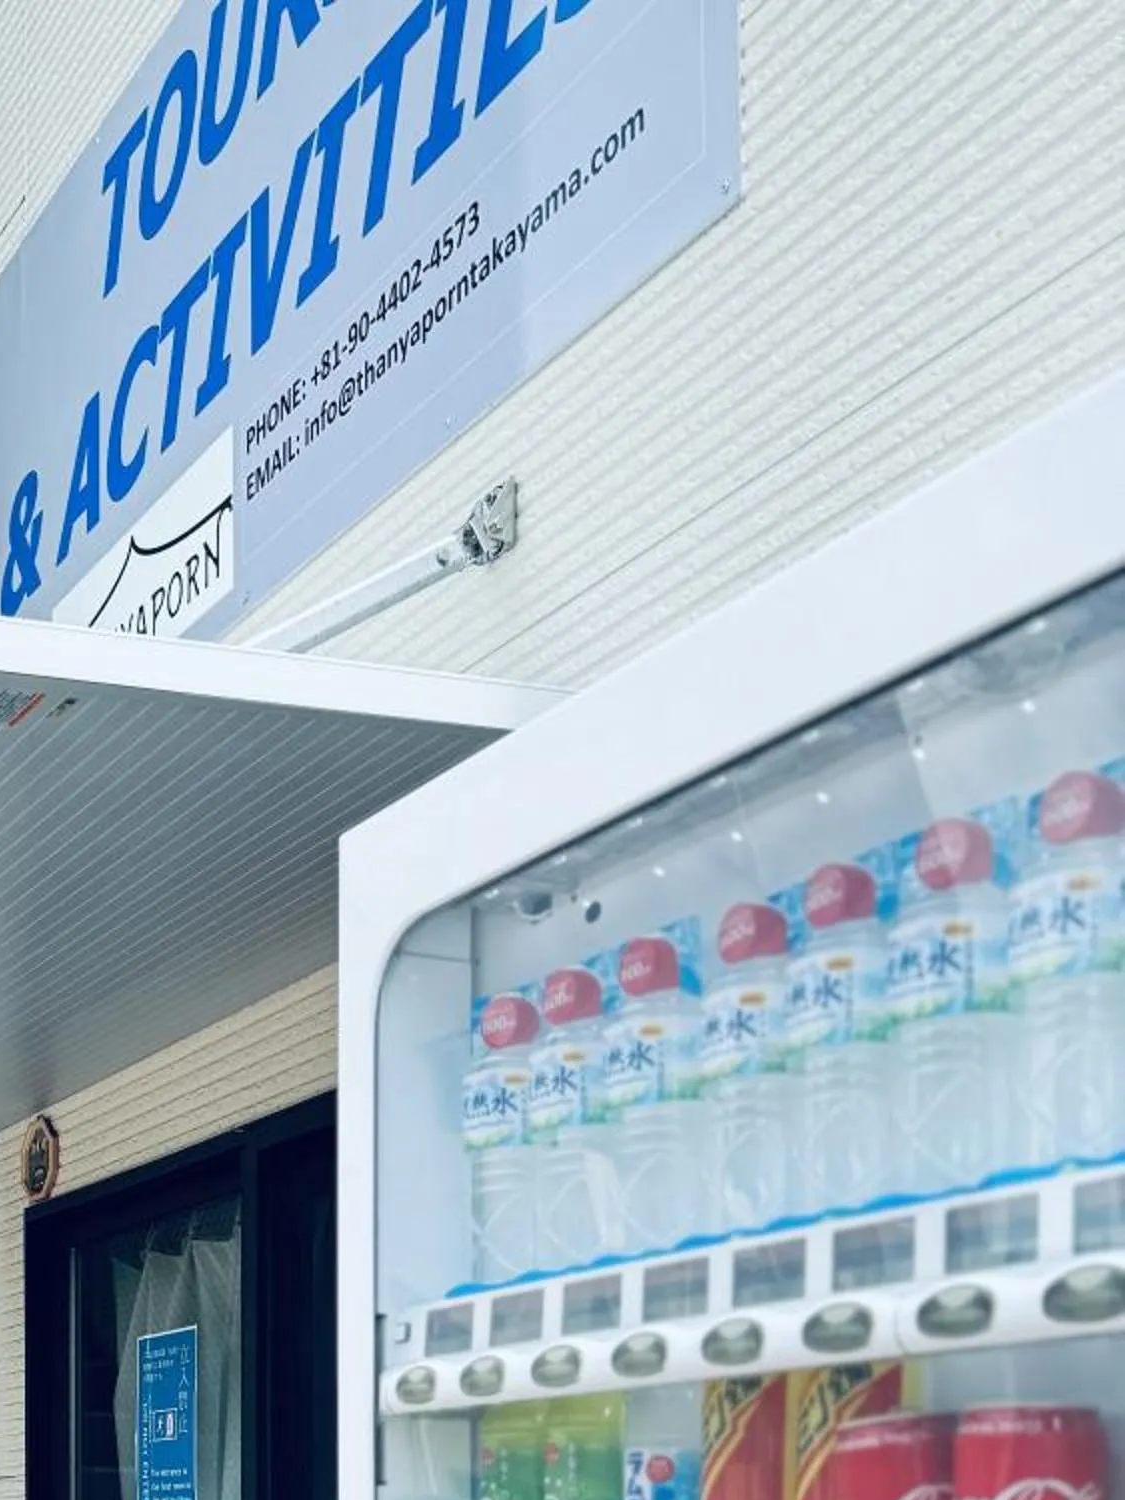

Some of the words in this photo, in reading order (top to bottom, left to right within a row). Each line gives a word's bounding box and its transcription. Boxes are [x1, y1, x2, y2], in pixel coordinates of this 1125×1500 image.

[246, 434, 300, 502] EMAIL:
[304, 107, 645, 448] info@thanyaporntakayama.com
[246, 378, 306, 454] PHONE:
[310, 200, 480, 388] +81-90-4402-4573
[0, 469, 43, 617] &
